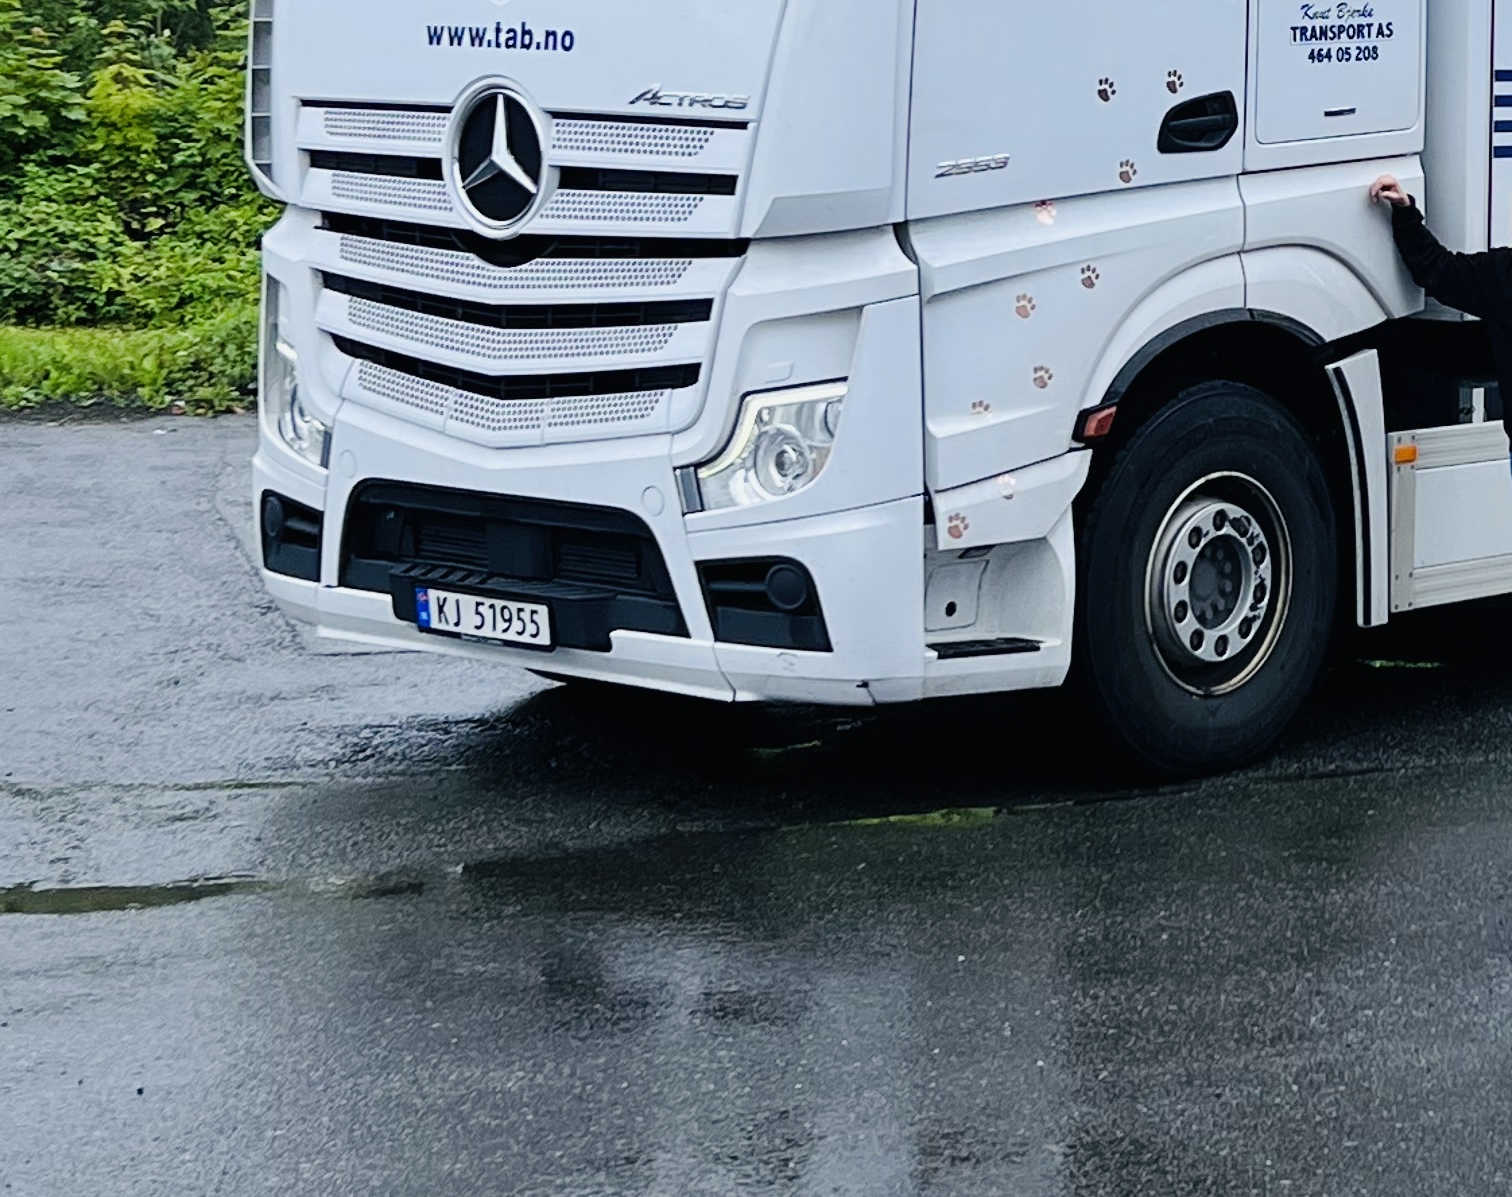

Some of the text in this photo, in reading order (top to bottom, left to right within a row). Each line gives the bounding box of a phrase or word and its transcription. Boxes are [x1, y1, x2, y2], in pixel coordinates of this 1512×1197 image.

[1336, 2, 1375, 23] Bjerke
[426, 21, 575, 52] www.tab.no
[1290, 21, 1394, 43] TRANSPORT AS
[1308, 45, 1379, 63] 464 05 208
[436, 595, 541, 639] KJ 51955
